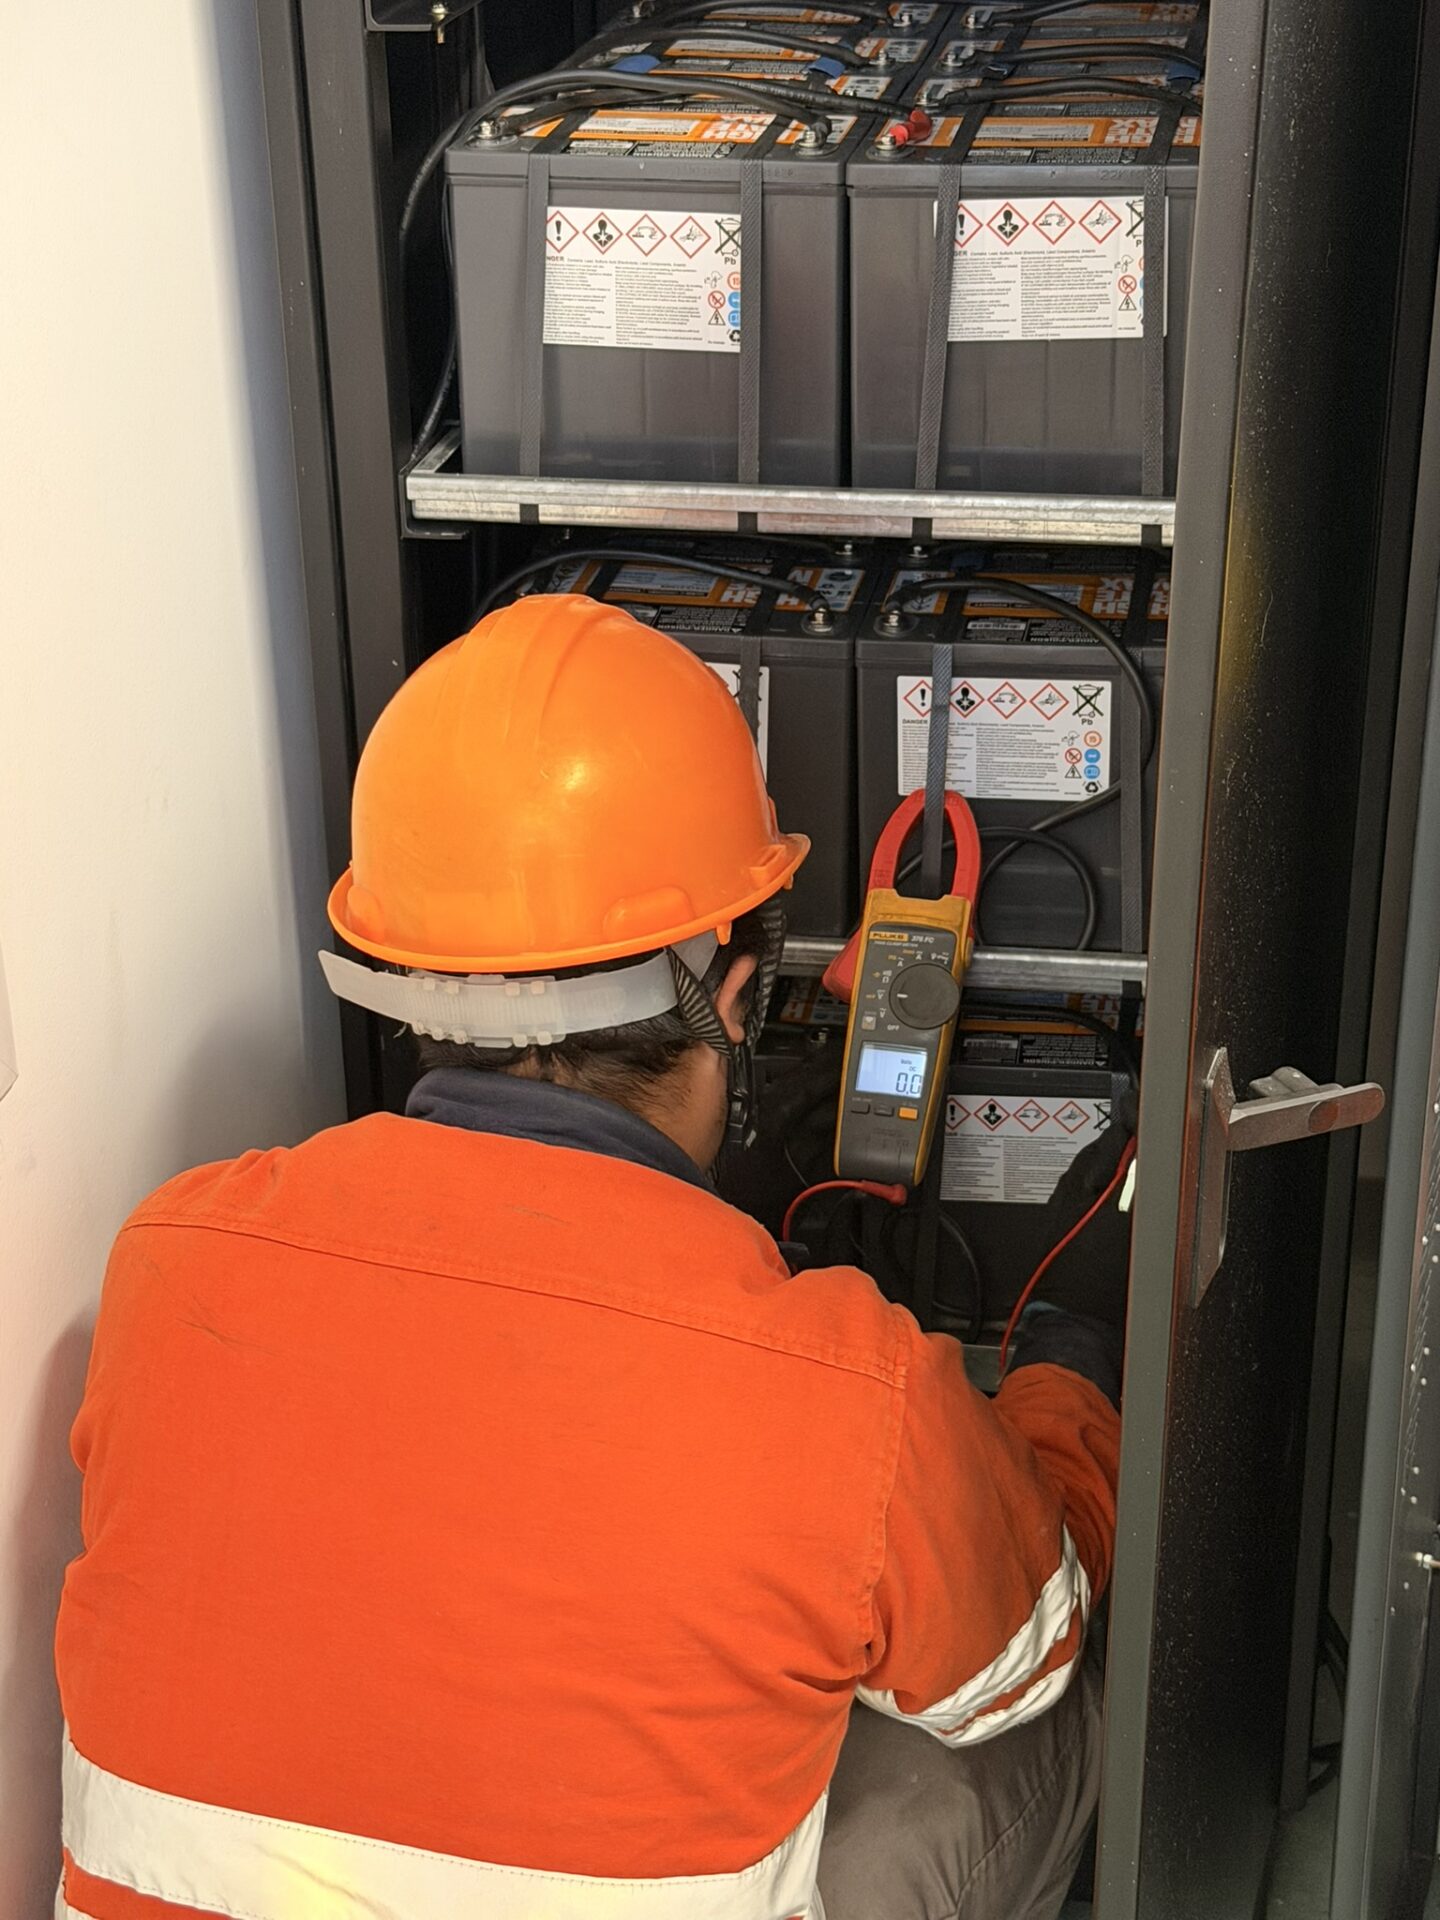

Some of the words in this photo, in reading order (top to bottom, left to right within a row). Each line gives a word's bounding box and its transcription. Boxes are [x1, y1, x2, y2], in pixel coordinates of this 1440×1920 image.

[1135, 239, 1142, 248] P
[724, 257, 737, 265] Pb
[872, 932, 905, 940] FLUKE
